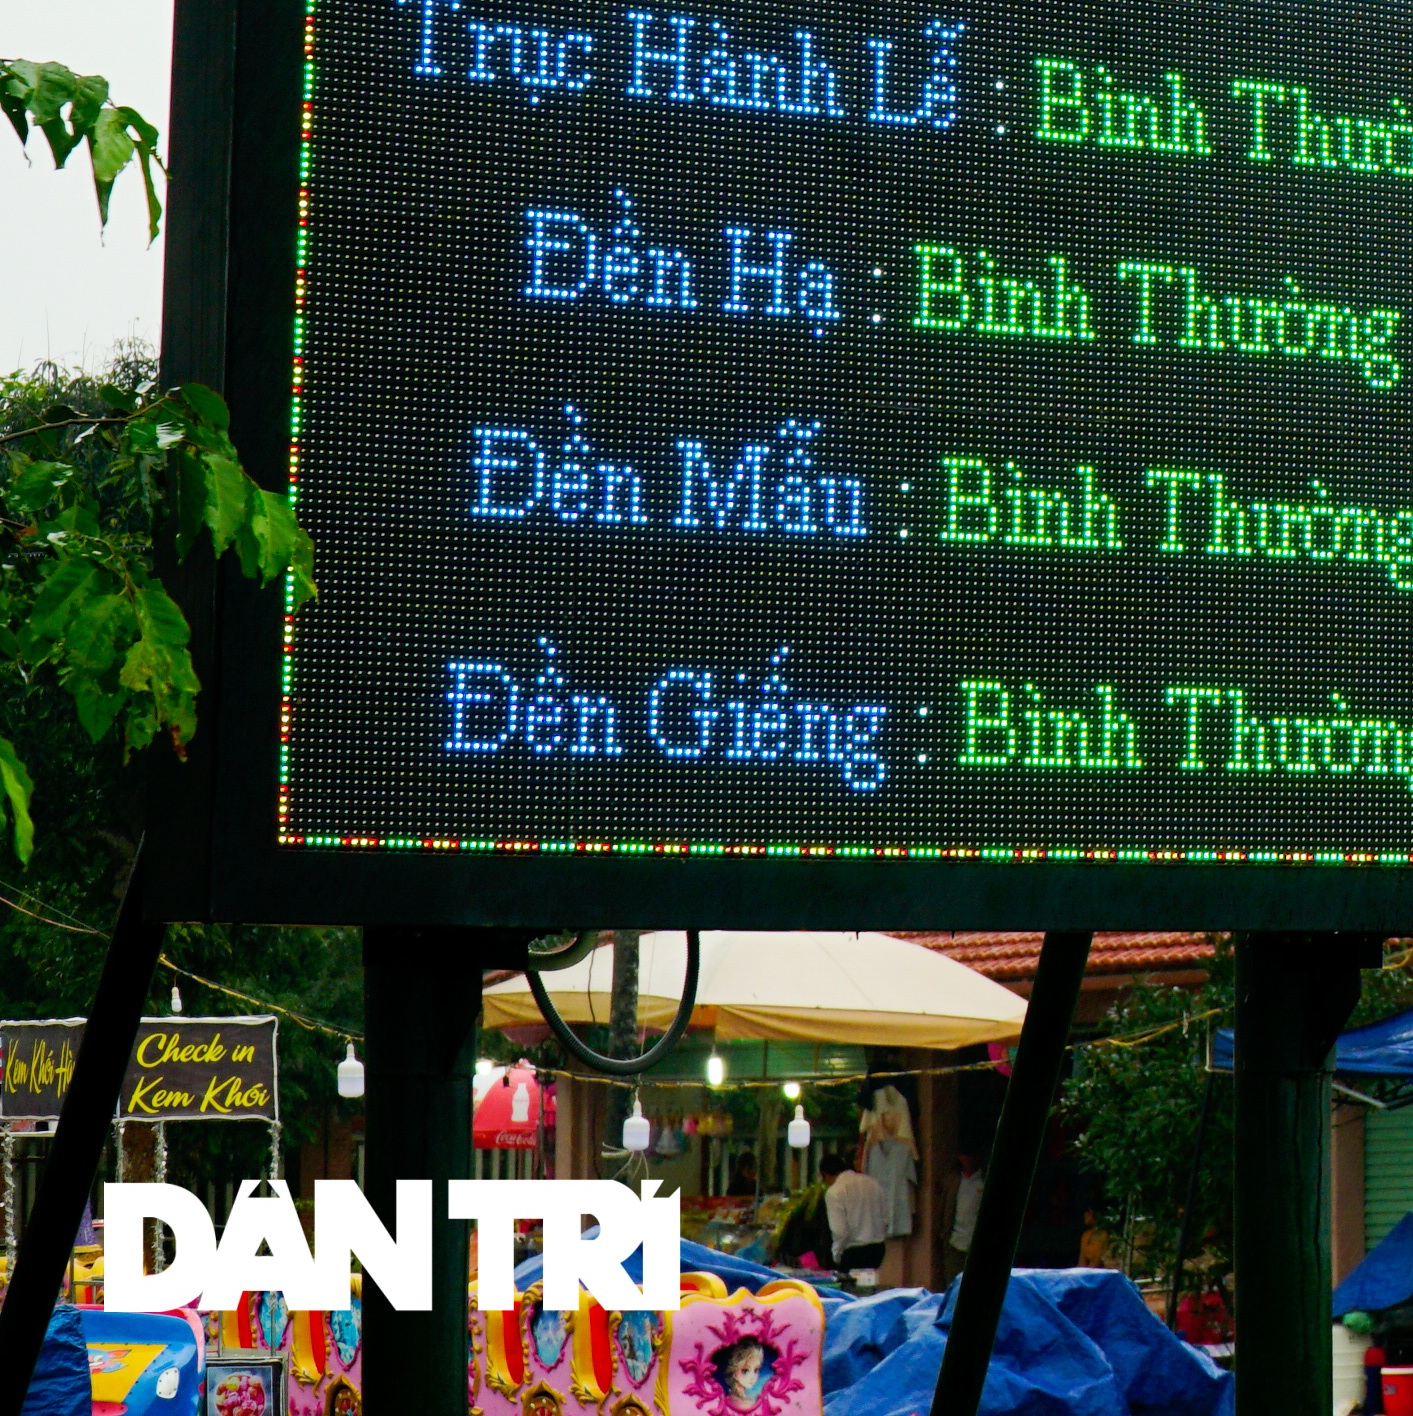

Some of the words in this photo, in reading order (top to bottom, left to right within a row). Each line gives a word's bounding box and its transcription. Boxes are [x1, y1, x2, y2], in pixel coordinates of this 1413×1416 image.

[626, 9, 845, 119] Hành
[868, 20, 968, 128] Lễ
[1034, 58, 1213, 155] Bình
[524, 188, 698, 310] Đền
[722, 226, 840, 338] Hạ
[912, 245, 1095, 339] Bình
[1118, 262, 1402, 390] Thường
[471, 403, 648, 524] Đền
[674, 417, 868, 536] Mẫu
[940, 456, 1124, 550] Bình
[443, 636, 624, 755] Đền
[648, 645, 888, 791] Giếng
[959, 678, 1143, 770] Bình
[127, 1076, 195, 1114] Kem
[199, 1075, 271, 1114] Khói
[136, 1032, 229, 1068] Check
[231, 1043, 255, 1063] in
